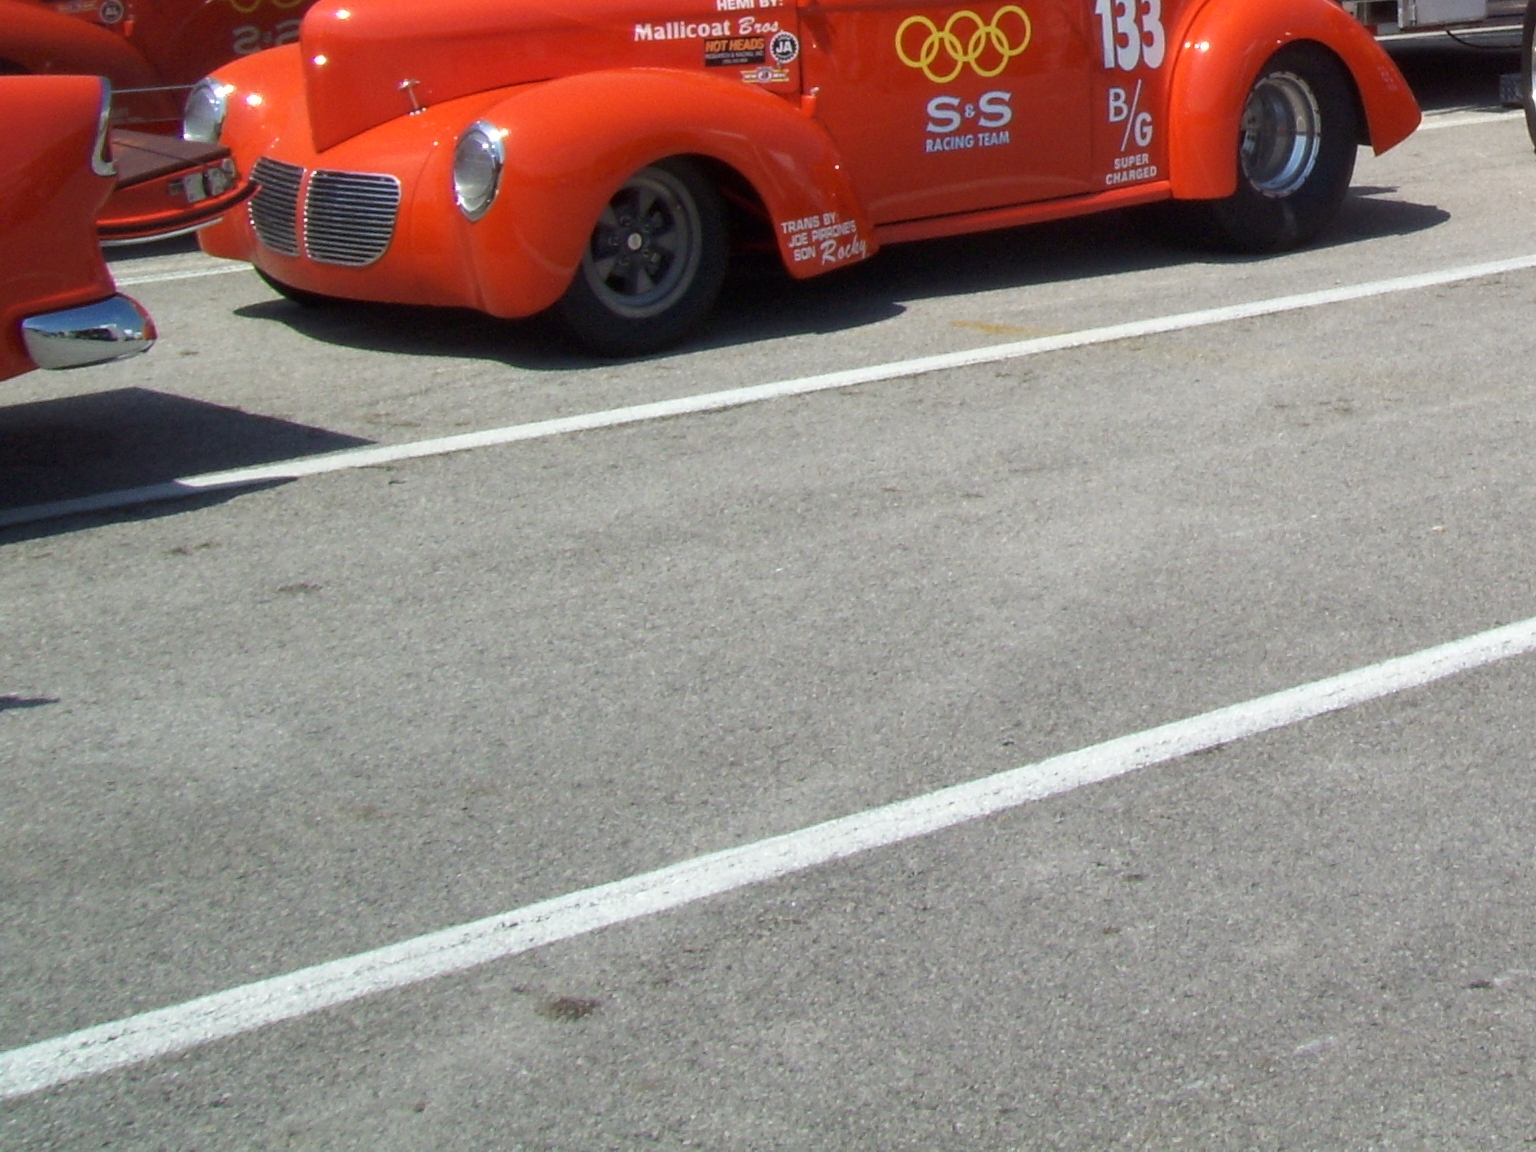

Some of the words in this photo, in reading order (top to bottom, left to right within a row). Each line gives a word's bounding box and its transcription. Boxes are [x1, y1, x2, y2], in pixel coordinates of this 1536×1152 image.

[634, 19, 731, 42] Mallicoat
[705, 40, 728, 53] HOT
[729, 38, 765, 51] HEADS
[776, 41, 793, 53] JA
[1108, 78, 1153, 152] B/G
[925, 134, 975, 153] RACING
[977, 130, 1010, 146] TEAM
[1114, 153, 1149, 170] SUPER
[1105, 165, 1157, 185] CHARGED
[780, 215, 820, 234] TRANS
[788, 232, 808, 248] JOE
[793, 246, 816, 261] SON
[820, 234, 866, 265] Rocky
